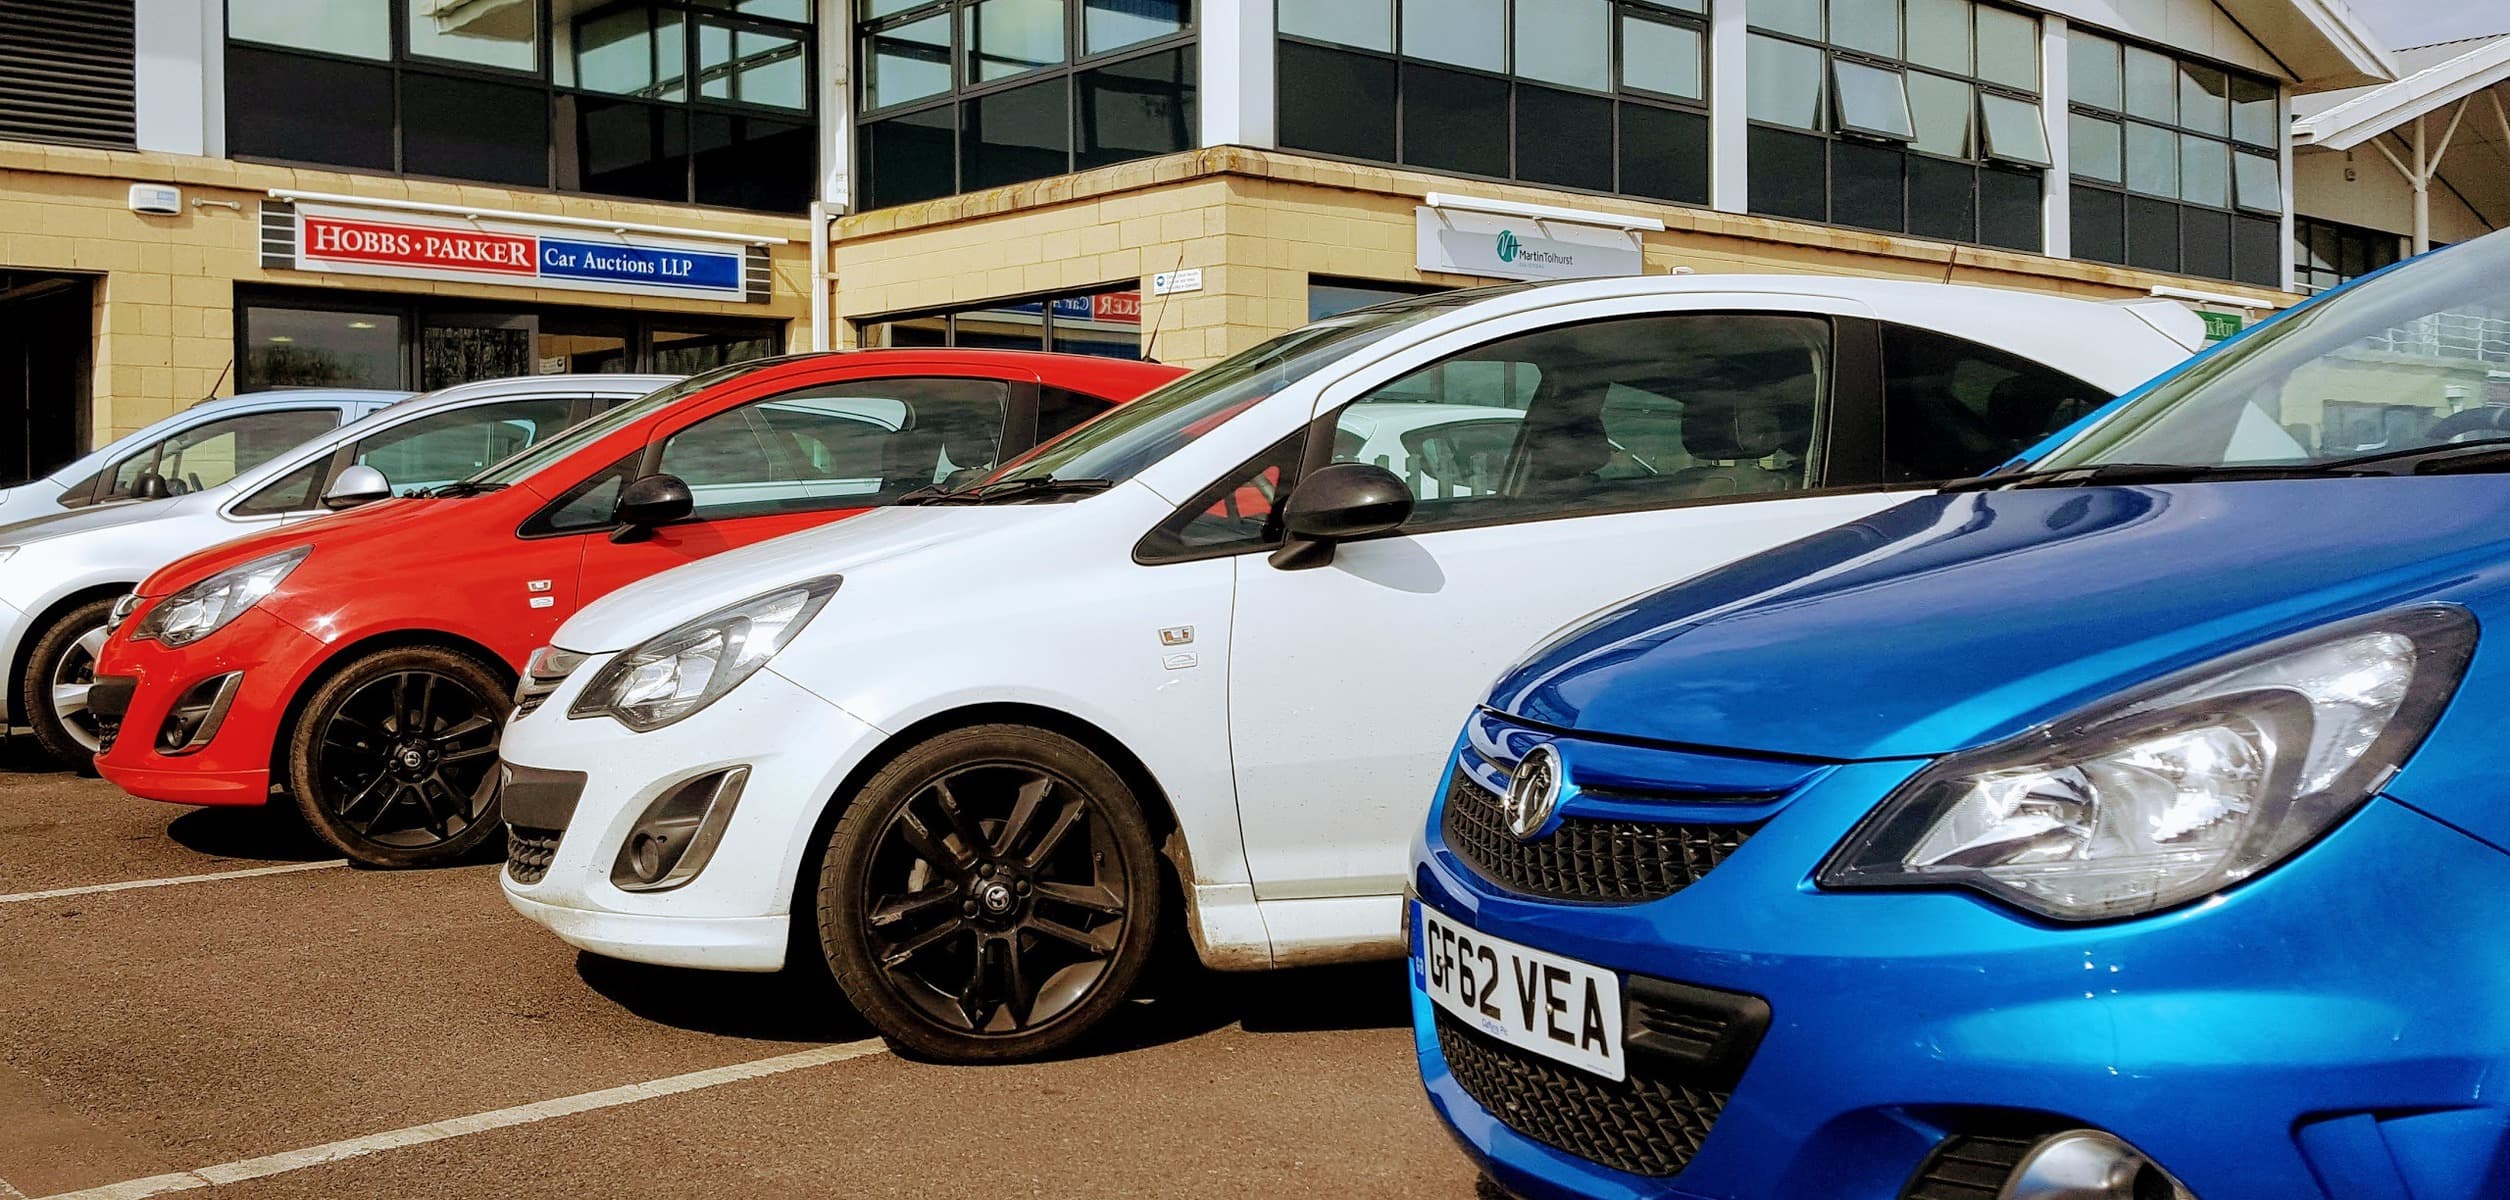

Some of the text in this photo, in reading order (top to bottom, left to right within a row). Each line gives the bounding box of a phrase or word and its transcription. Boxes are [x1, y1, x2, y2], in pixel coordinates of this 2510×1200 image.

[544, 248, 693, 277] Car Auctions LLP
[1428, 919, 1610, 1059] GF62 VEA
